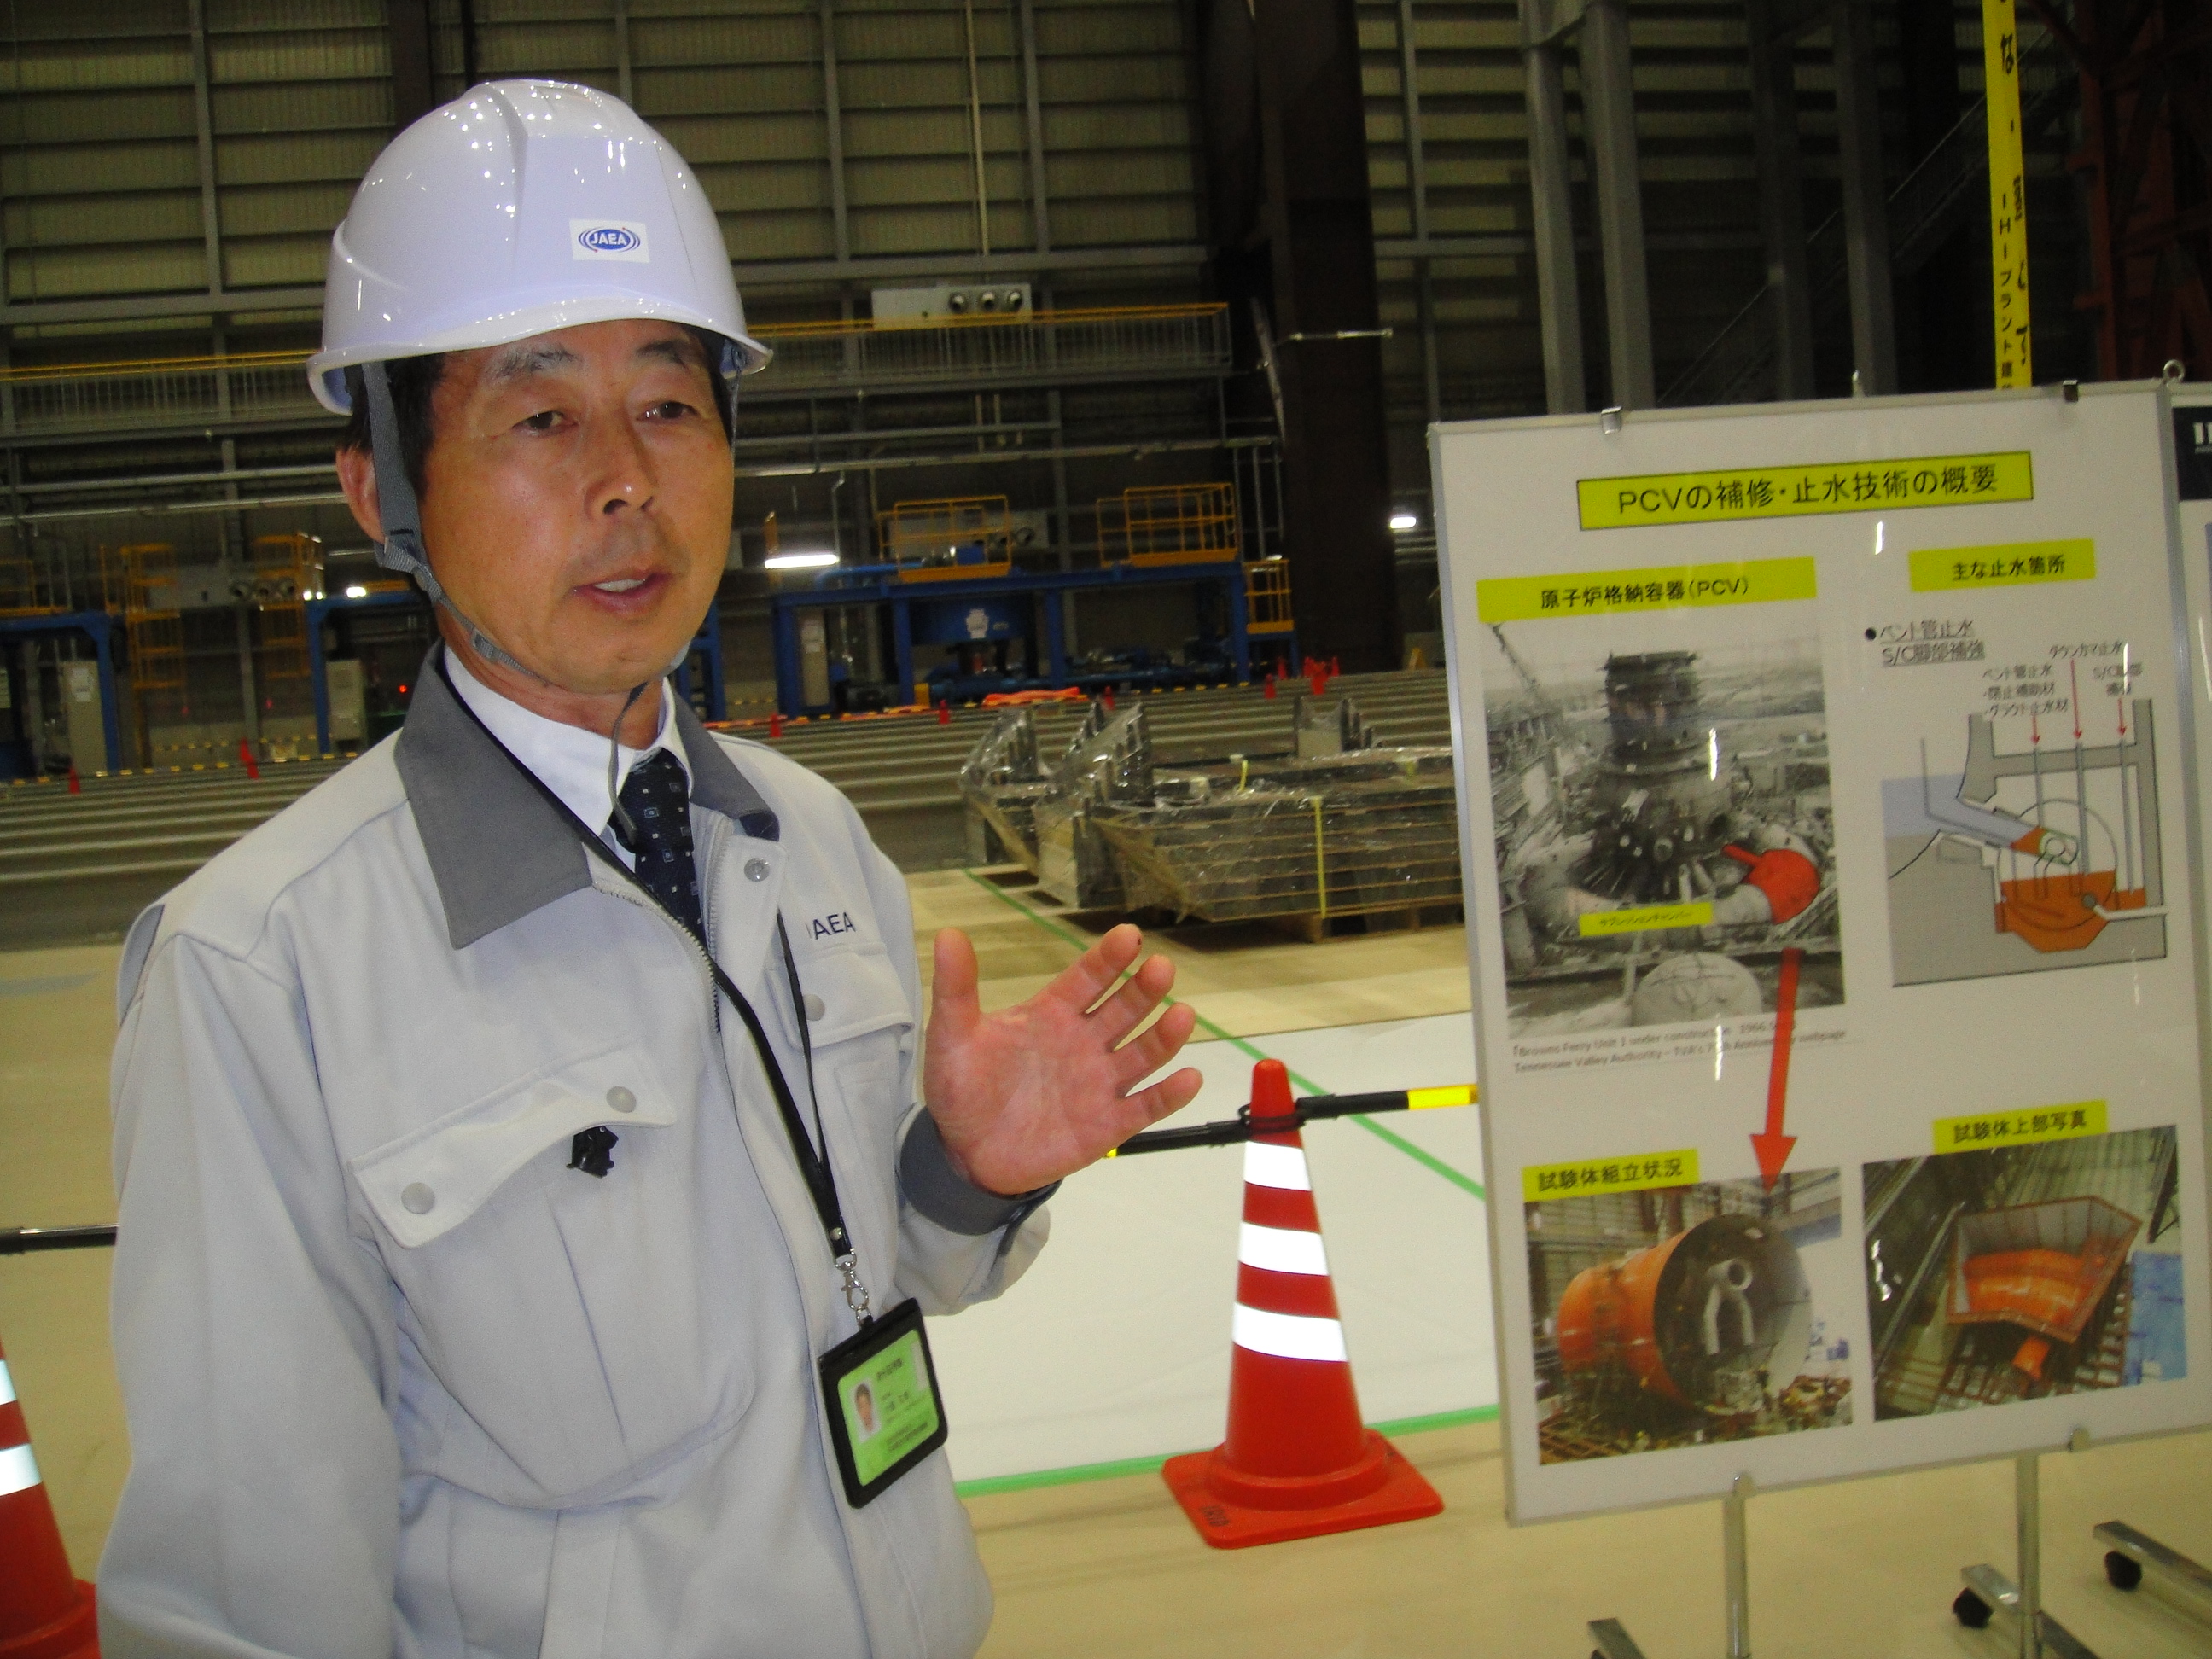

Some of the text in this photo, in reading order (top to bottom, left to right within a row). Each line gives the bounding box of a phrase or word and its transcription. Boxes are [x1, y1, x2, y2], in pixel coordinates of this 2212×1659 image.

[591, 231, 627, 246] JAEA
[1951, 554, 2065, 581] 主な止水箇所
[1538, 1157, 1684, 1193] 試験体組立状況
